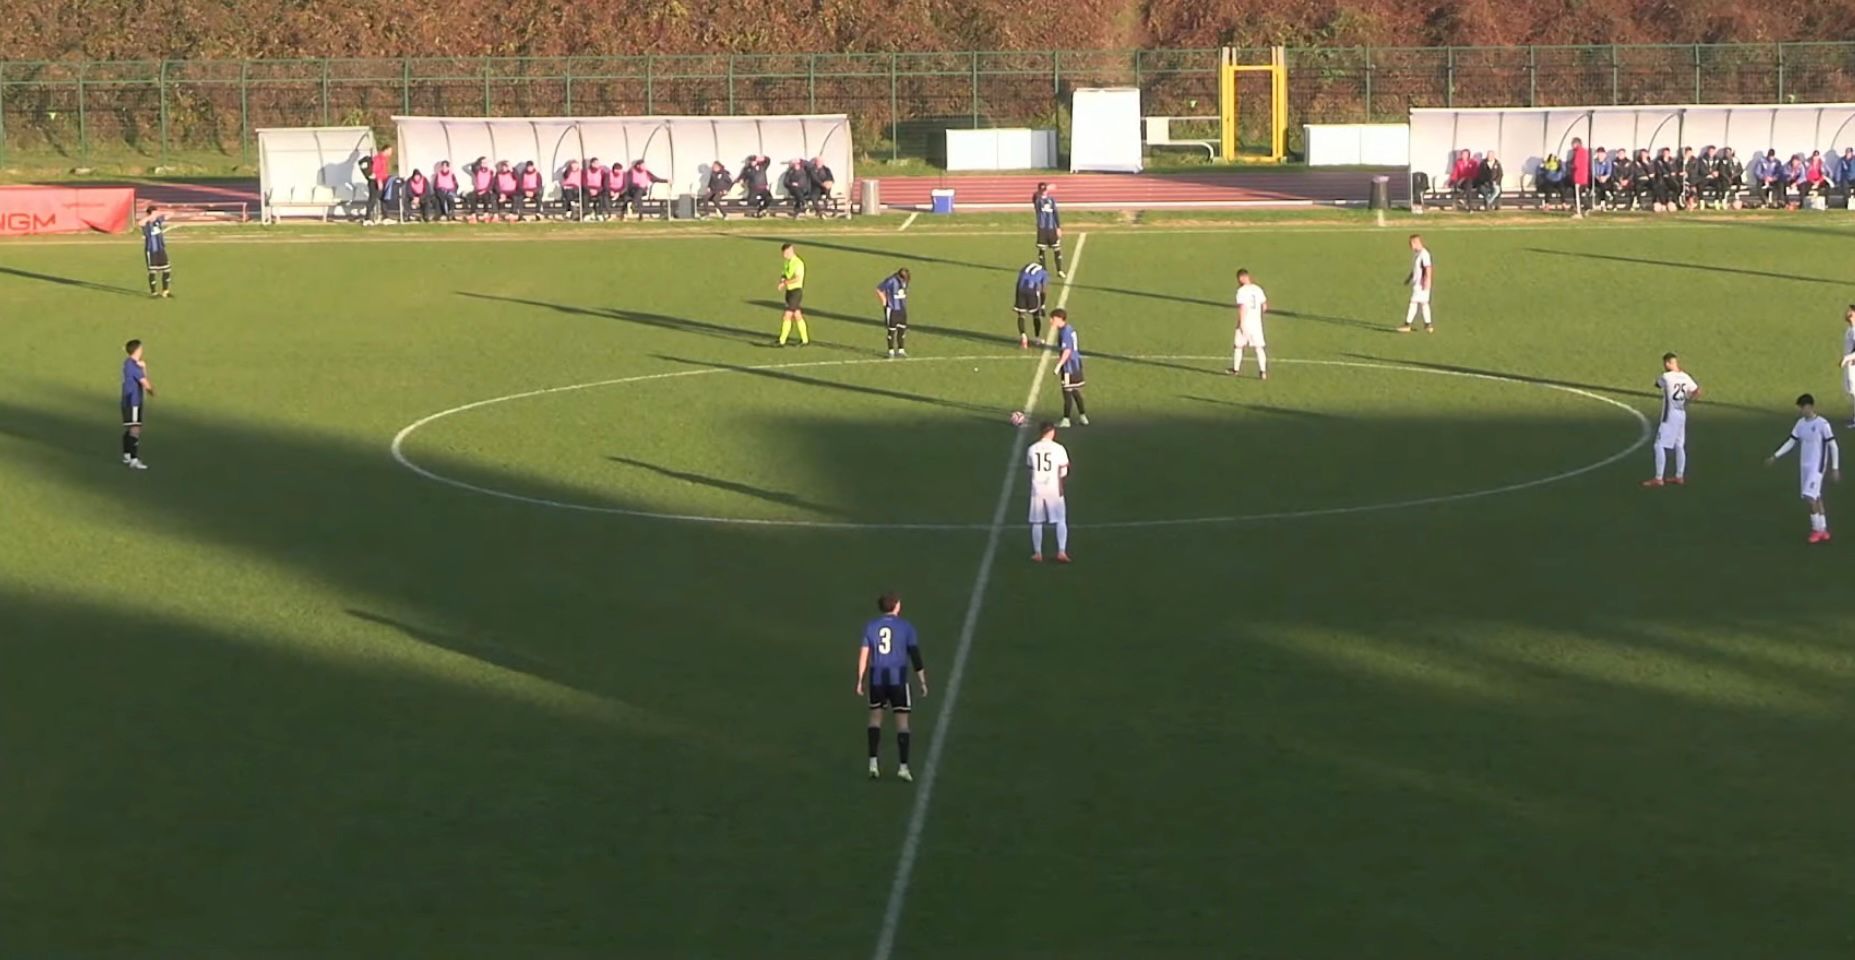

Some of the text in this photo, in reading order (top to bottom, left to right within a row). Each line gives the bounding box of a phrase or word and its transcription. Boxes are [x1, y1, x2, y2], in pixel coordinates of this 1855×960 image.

[0, 213, 56, 230] GM
[1035, 452, 1052, 472] 15
[878, 626, 892, 655] 3
